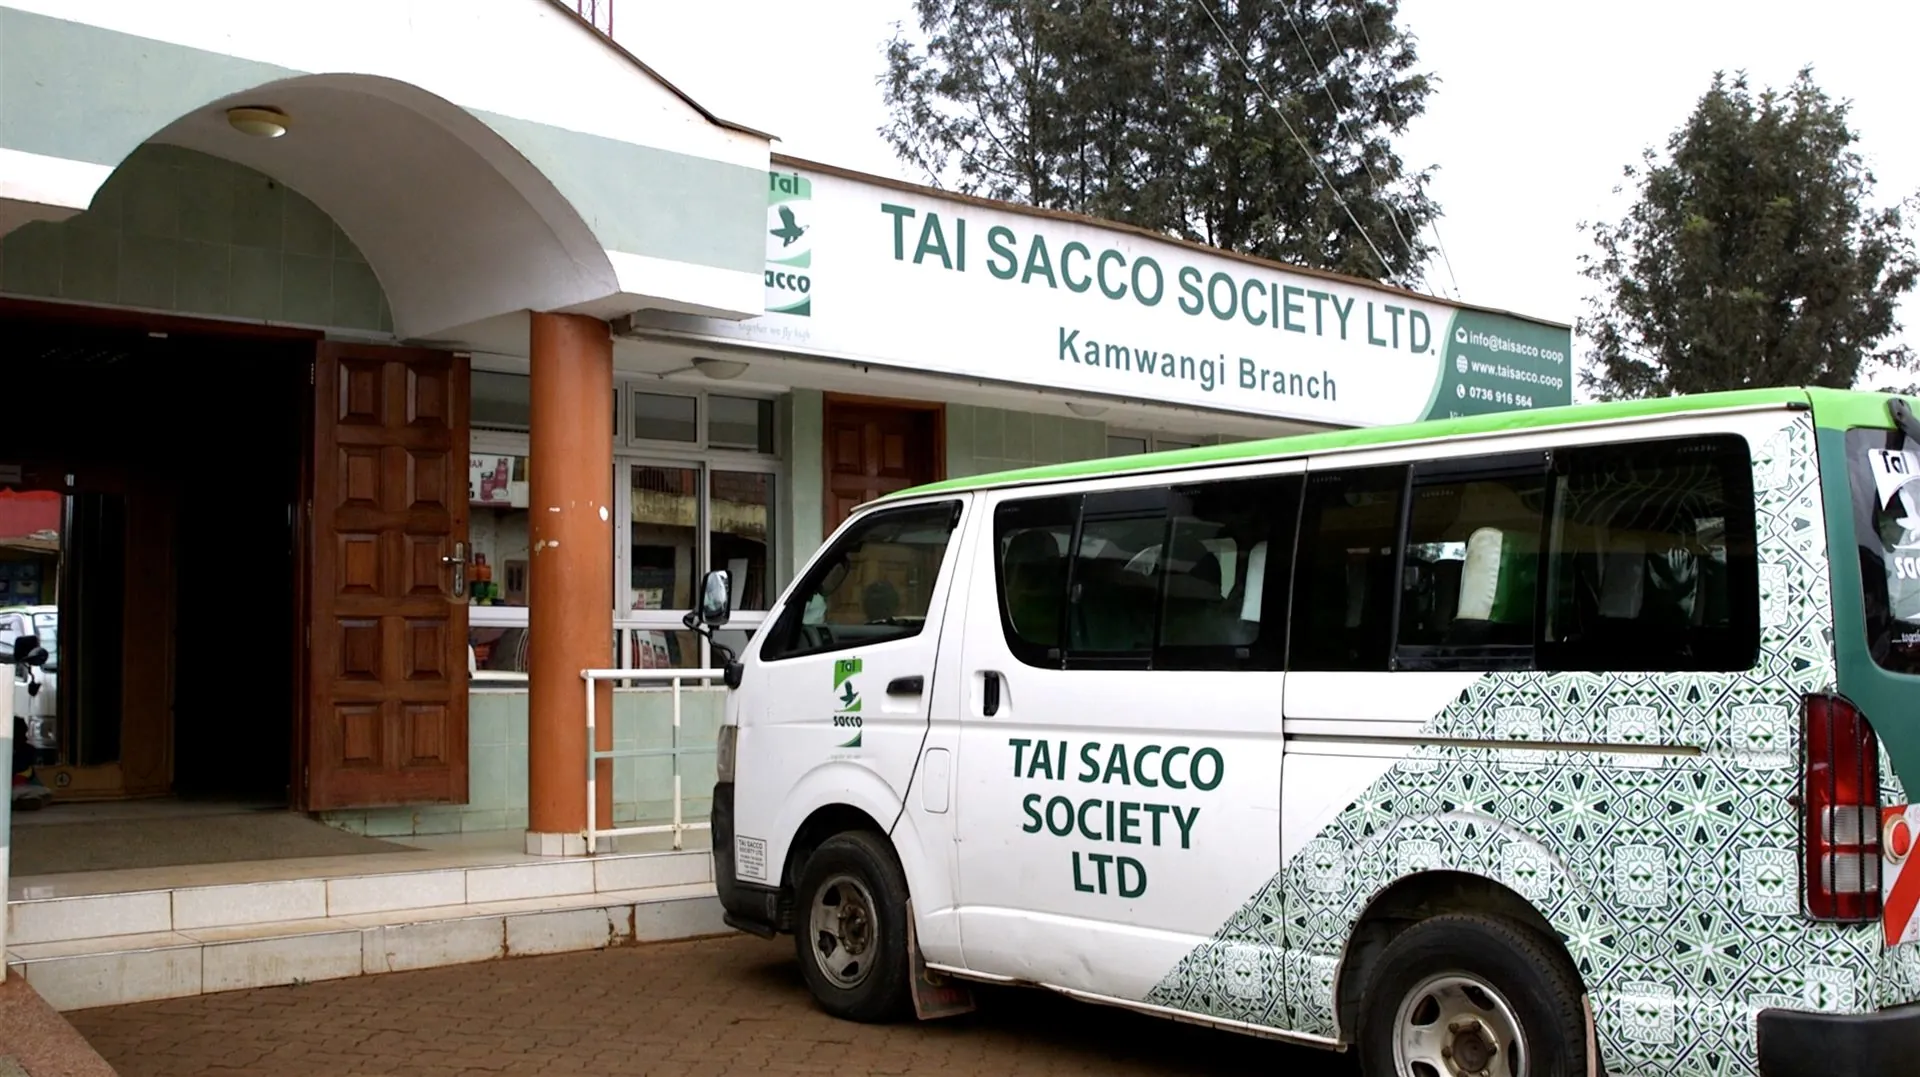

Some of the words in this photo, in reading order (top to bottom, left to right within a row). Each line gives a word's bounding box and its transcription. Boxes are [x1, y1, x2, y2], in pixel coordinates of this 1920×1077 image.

[769, 171, 799, 195] Tai
[764, 270, 811, 293] acco
[881, 203, 966, 272] TAI
[986, 225, 1164, 307] SACCO
[1178, 266, 1355, 340] SOCIETY
[1367, 302, 1435, 355] LTD.
[1059, 327, 1225, 392] Kamwangi
[1239, 357, 1336, 401] Branch
[1471, 361, 1563, 389] www.taisacco.coop
[1470, 386, 1493, 401] 0736
[1496, 391, 1513, 404] 916
[1515, 394, 1532, 407] 564
[841, 655, 856, 672] Tai
[833, 715, 863, 728] sacco
[1008, 738, 1068, 781] TAI
[1078, 742, 1225, 791] SACCO
[1022, 793, 1201, 850] SOCIETY
[1072, 851, 1148, 899] LTD
